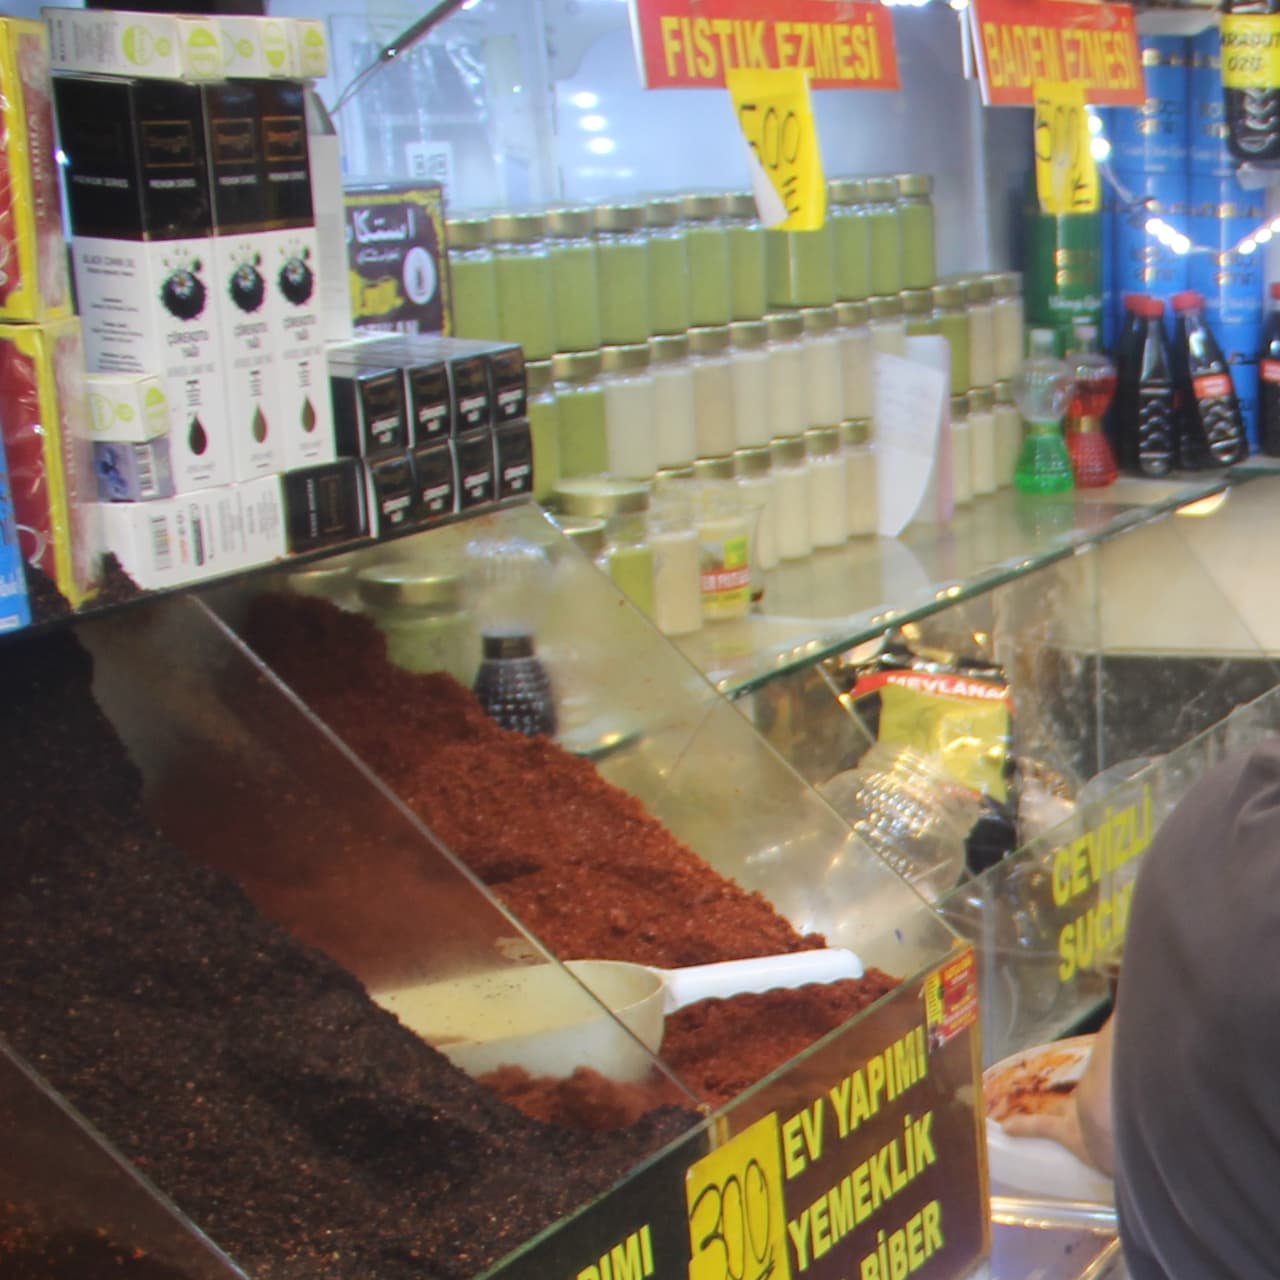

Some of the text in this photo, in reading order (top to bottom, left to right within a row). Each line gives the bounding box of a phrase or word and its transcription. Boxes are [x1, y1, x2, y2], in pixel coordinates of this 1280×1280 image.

[660, 12, 882, 81] FISTIK EZMESİ
[983, 21, 1062, 88] BADEM
[782, 1025, 928, 1181] EV YAPIMI
[787, 1110, 939, 1274] YEMEKLİK
